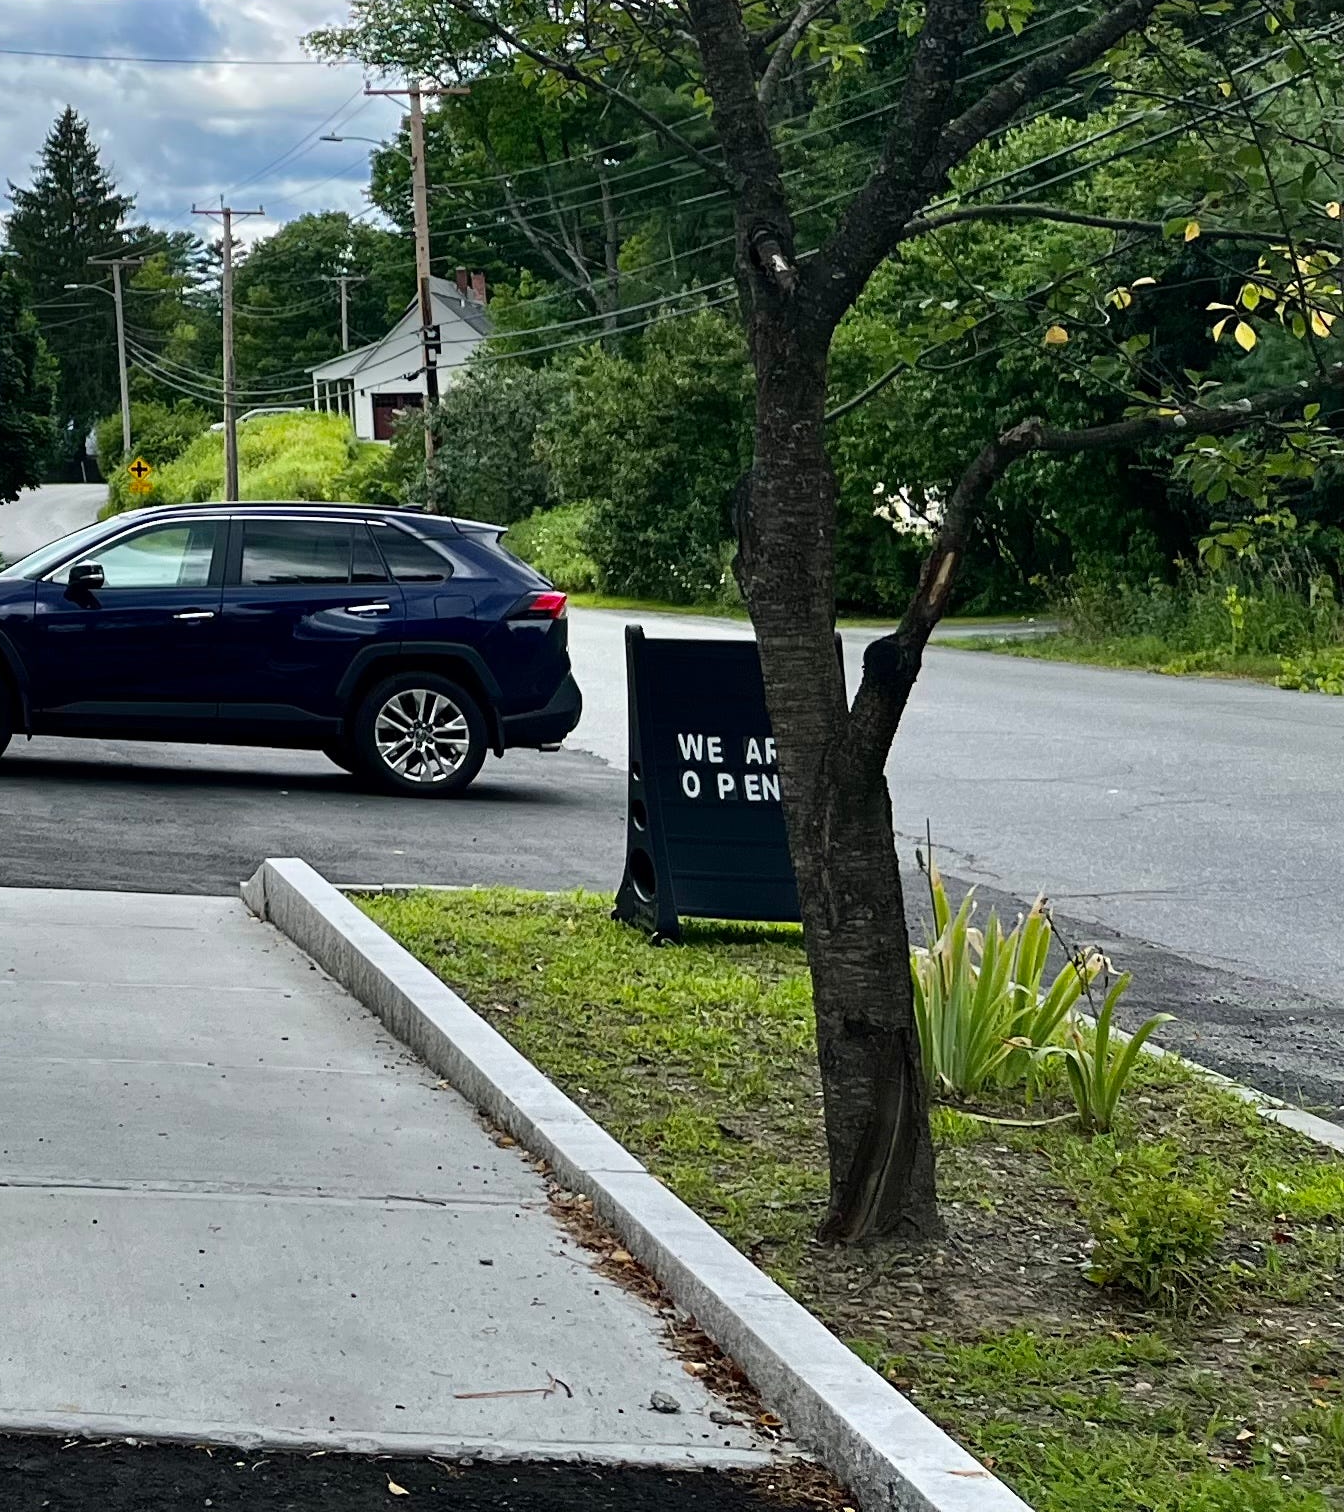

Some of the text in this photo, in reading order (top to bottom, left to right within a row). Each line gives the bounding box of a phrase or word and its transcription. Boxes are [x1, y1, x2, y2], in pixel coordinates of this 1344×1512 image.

[677, 733, 777, 765] WE AR
[682, 770, 781, 802] OPEN
